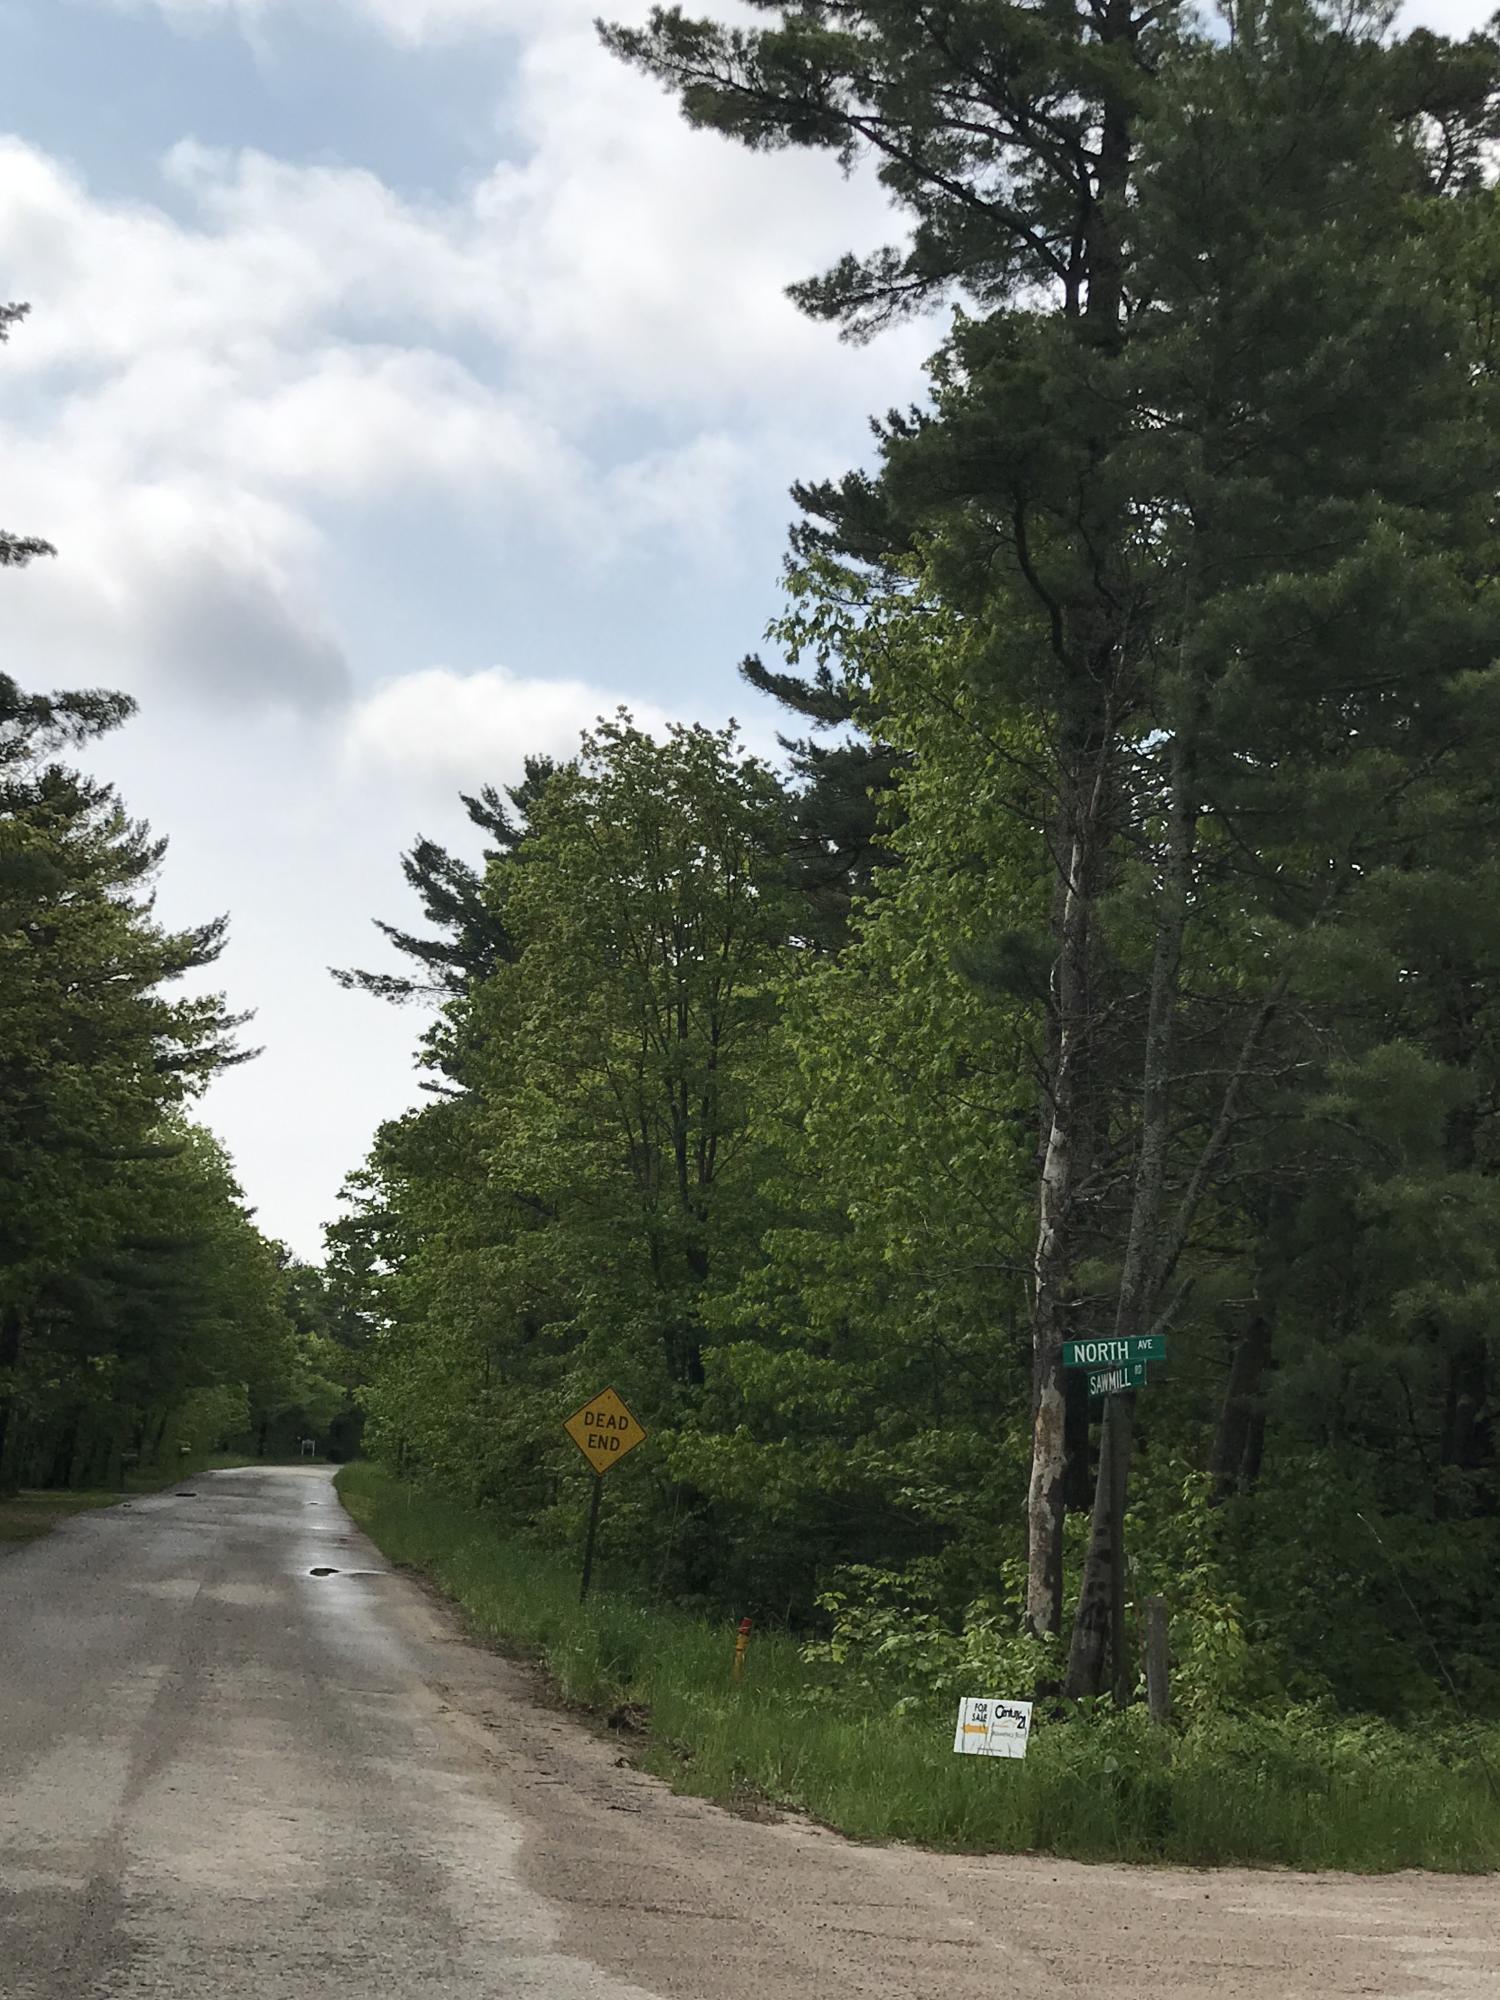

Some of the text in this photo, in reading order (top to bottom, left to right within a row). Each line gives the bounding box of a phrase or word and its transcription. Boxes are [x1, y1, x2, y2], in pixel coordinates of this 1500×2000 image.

[1074, 1339, 1153, 1362] NORTH AVE
[1090, 1368, 1131, 1395] SAWMILL
[584, 1411, 628, 1430] DEAD
[588, 1433, 620, 1451] END
[974, 1703, 988, 1712] FOR
[972, 1713, 988, 1722] SALE
[1017, 1715, 1026, 1729] 21
